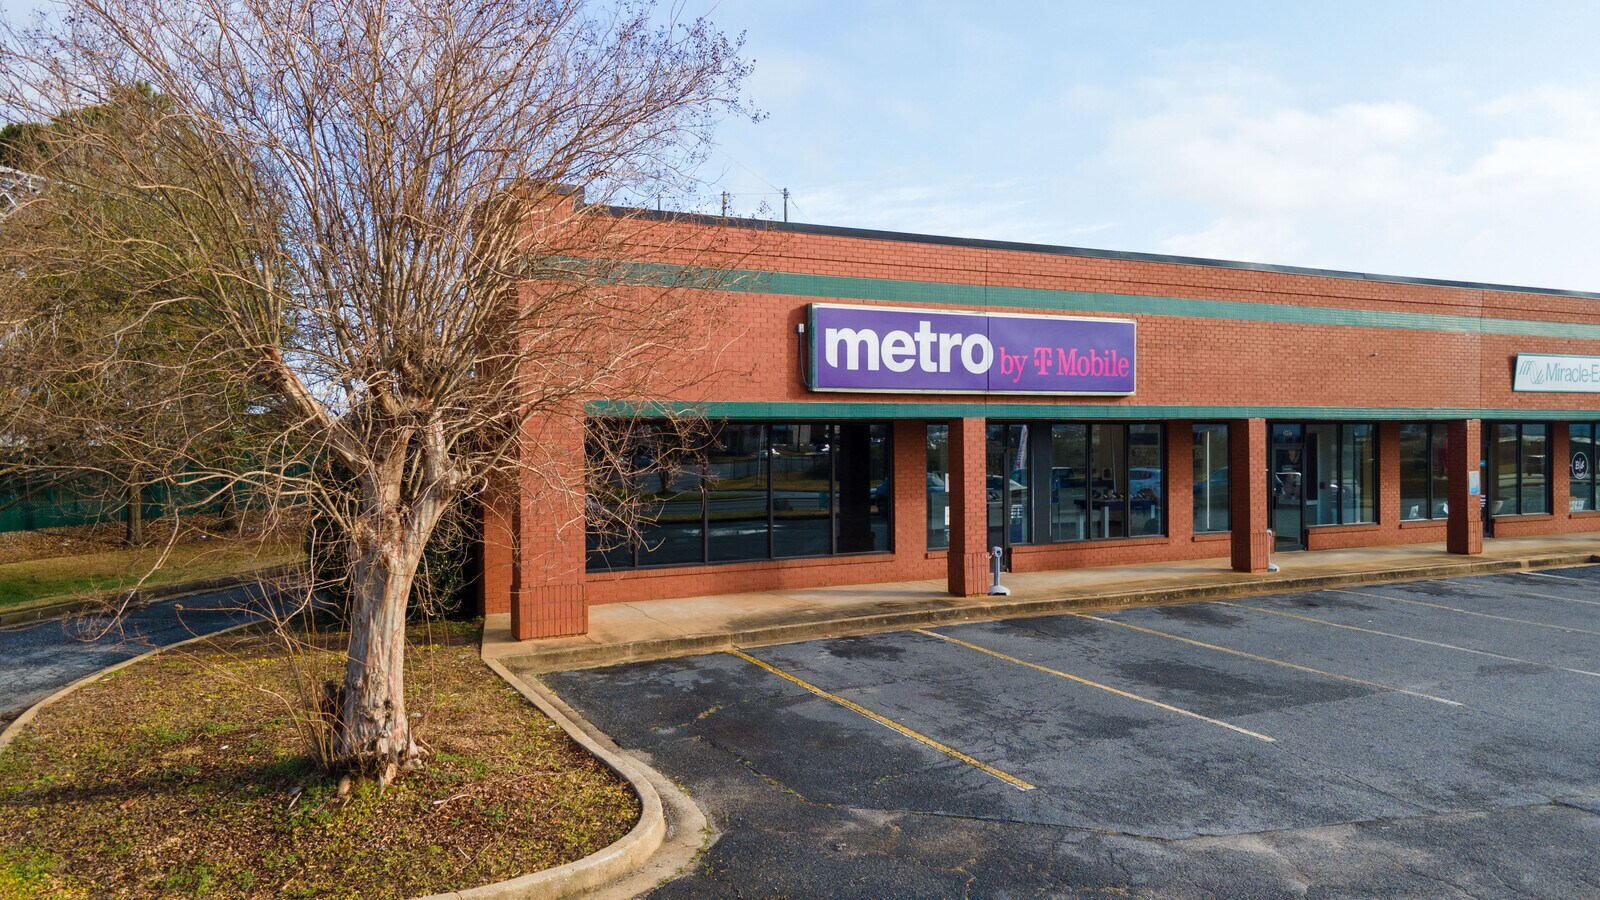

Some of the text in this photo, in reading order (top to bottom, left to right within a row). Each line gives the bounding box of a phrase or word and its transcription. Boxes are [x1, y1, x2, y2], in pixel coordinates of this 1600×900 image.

[825, 321, 993, 374] metro
[1000, 347, 1028, 383] by
[1057, 348, 1130, 377] Mobile
[1546, 362, 1600, 382] Miracle-E
